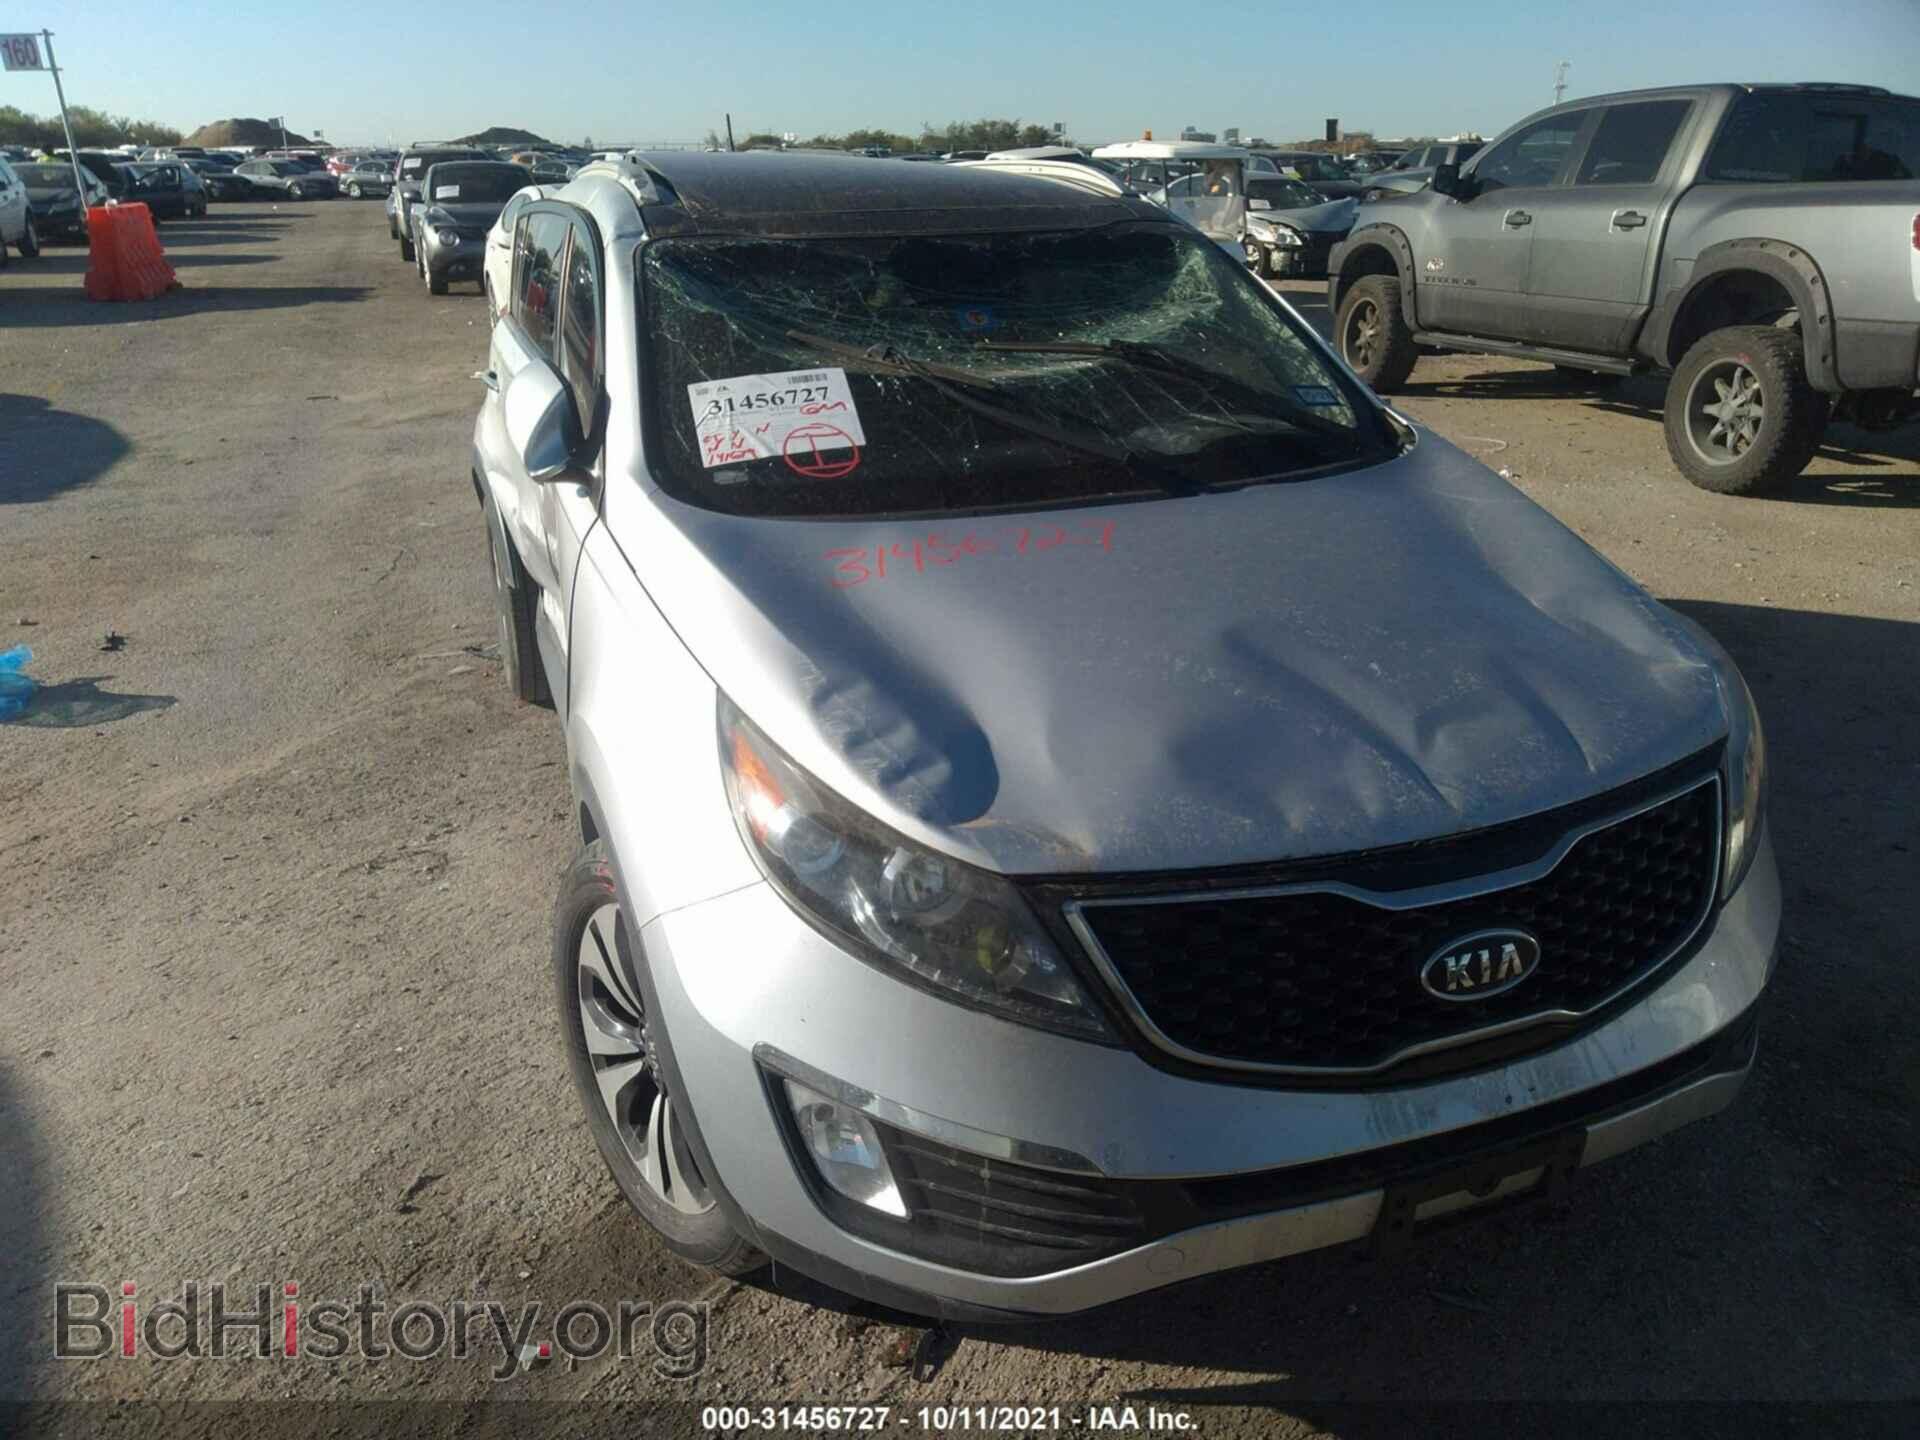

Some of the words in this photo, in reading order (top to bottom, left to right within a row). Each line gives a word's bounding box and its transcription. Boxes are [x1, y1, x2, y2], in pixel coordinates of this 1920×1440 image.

[2, 38, 38, 66] 160
[708, 386, 829, 416] 31456727
[1444, 942, 1523, 992] KIA
